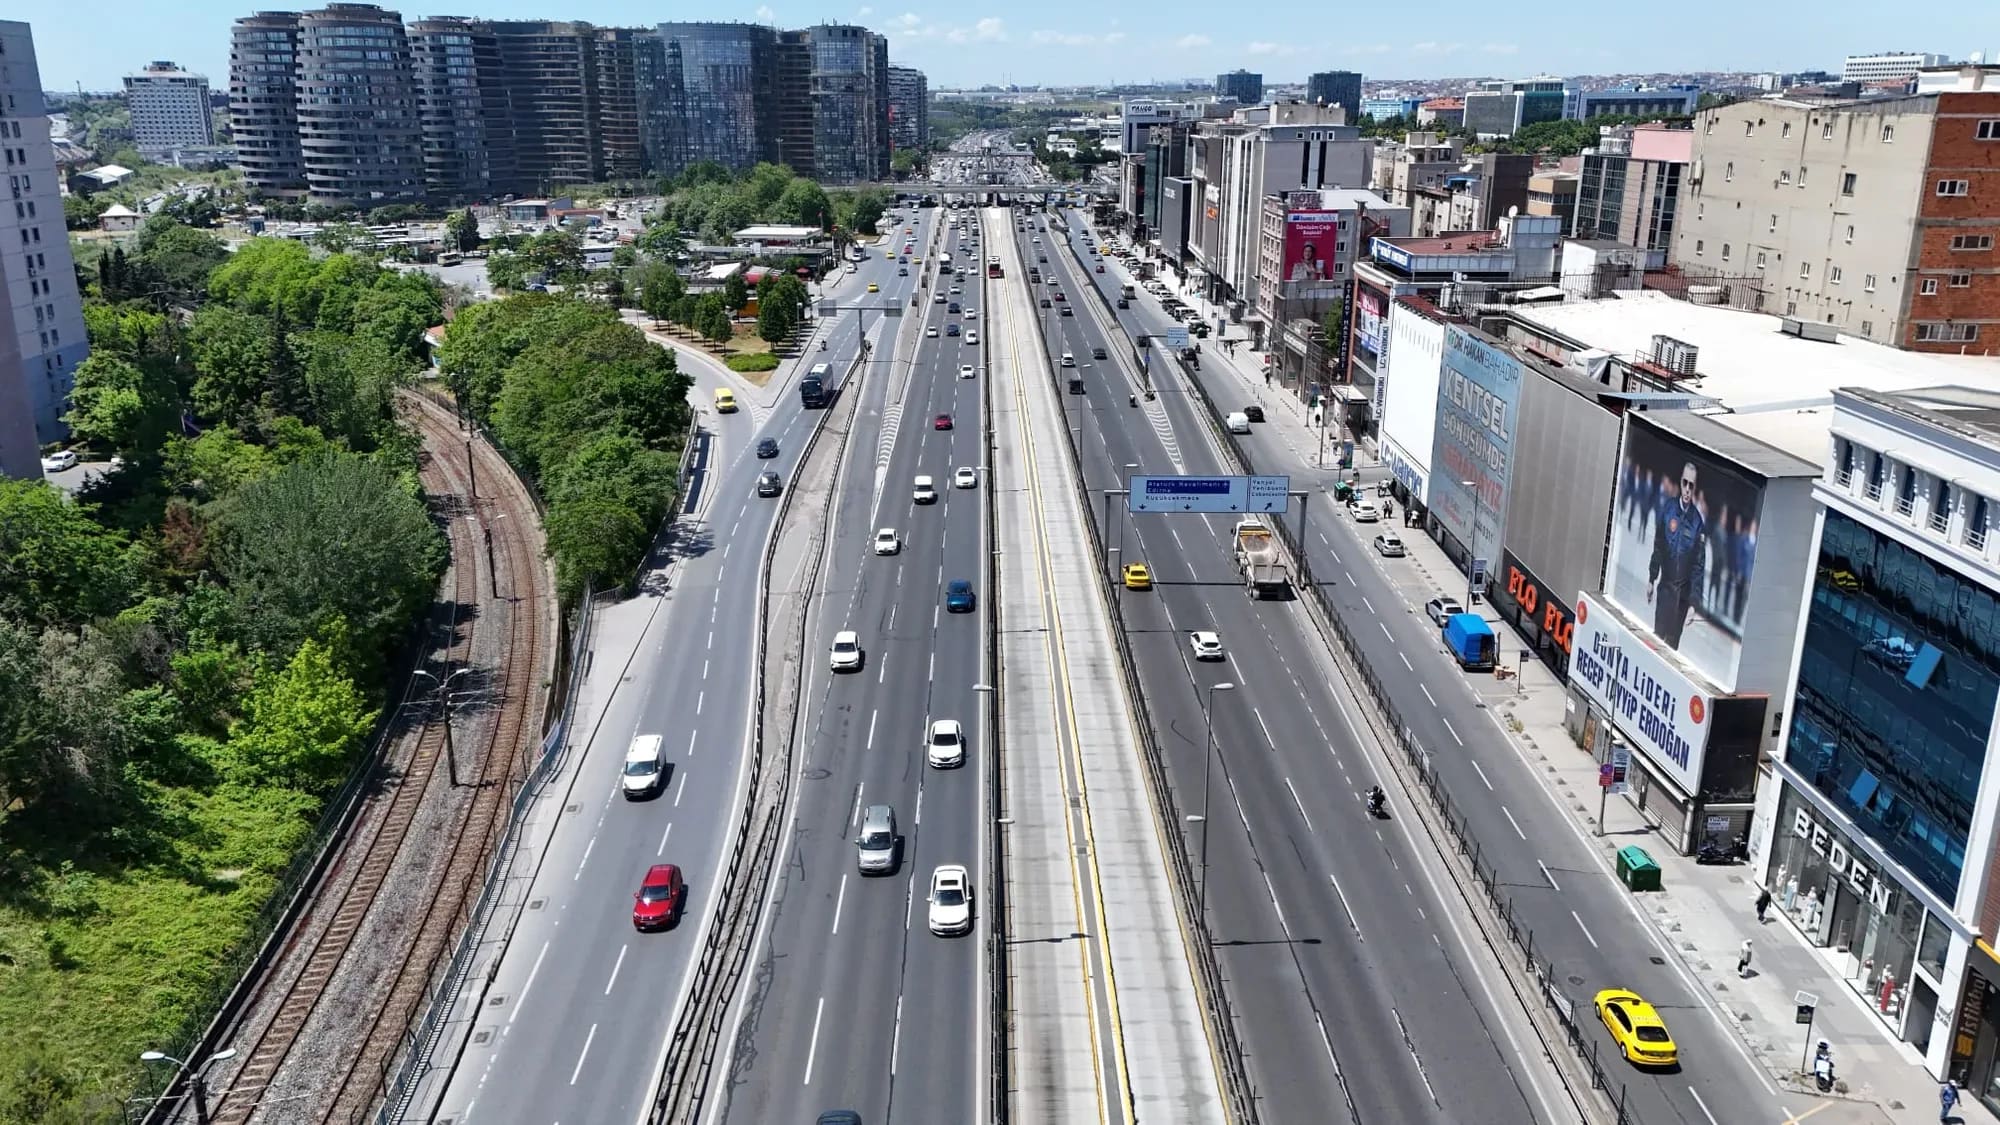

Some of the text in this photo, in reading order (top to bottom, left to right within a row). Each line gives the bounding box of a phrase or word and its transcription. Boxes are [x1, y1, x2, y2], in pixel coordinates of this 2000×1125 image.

[1463, 339, 1485, 366] HAKAN
[1444, 365, 1508, 442] KENTSEL
[1508, 565, 1538, 614] FLO
[1593, 631, 1629, 681] DÜNYA
[1576, 647, 1604, 690] RECEP
[1638, 704, 1690, 772] ERDOĞAN
[1793, 807, 1893, 916] BEDEN
